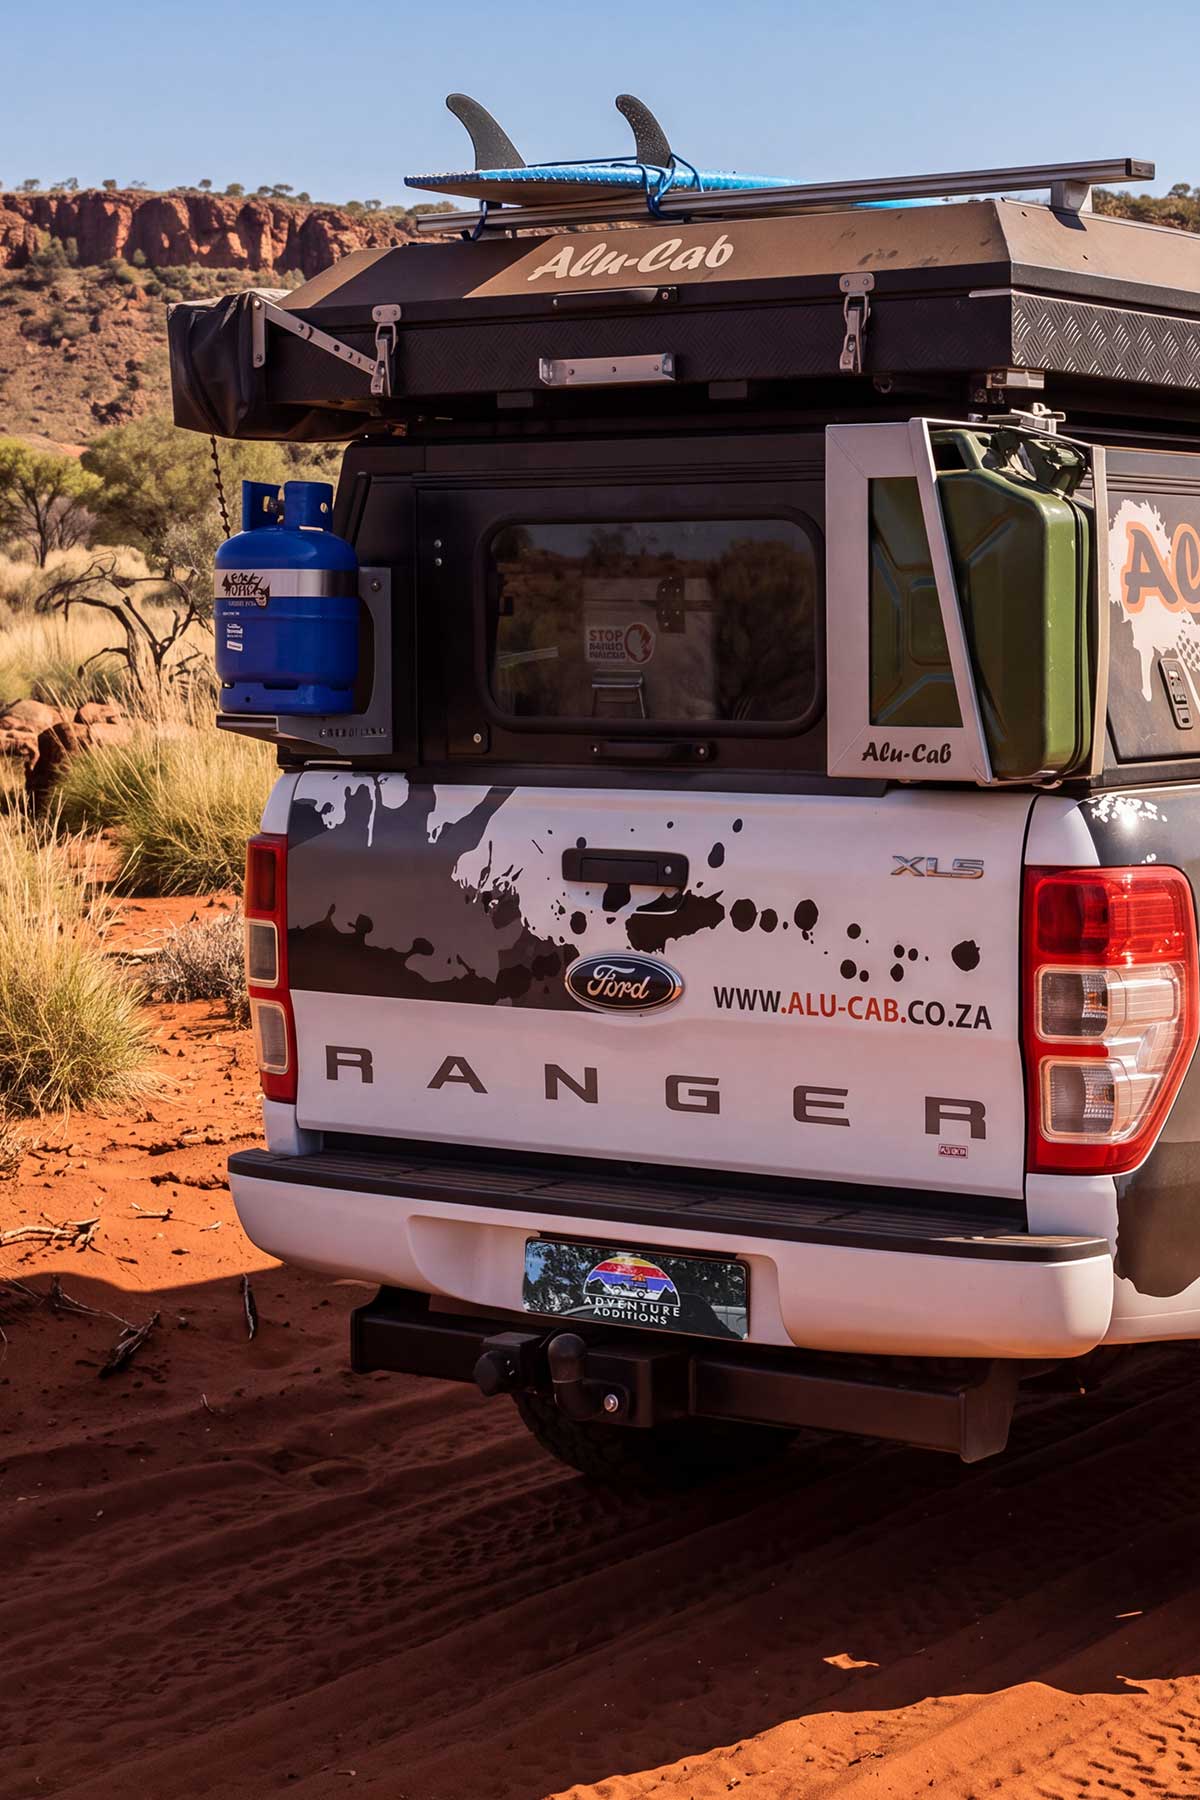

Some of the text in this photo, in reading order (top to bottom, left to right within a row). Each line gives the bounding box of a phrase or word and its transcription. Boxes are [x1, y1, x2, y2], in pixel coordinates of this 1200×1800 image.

[527, 234, 735, 281] Alu-Cab
[588, 629, 623, 642] STOP
[861, 741, 952, 764] Alu-Cab
[890, 855, 985, 880] XLS
[586, 964, 652, 1000] Ford
[713, 985, 993, 1031] WWW.ALU-CAB.CO.ZA
[325, 1044, 987, 1141] RANGER
[583, 1296, 681, 1318] ADVENTURE
[592, 1307, 668, 1326] ADDITIONS
